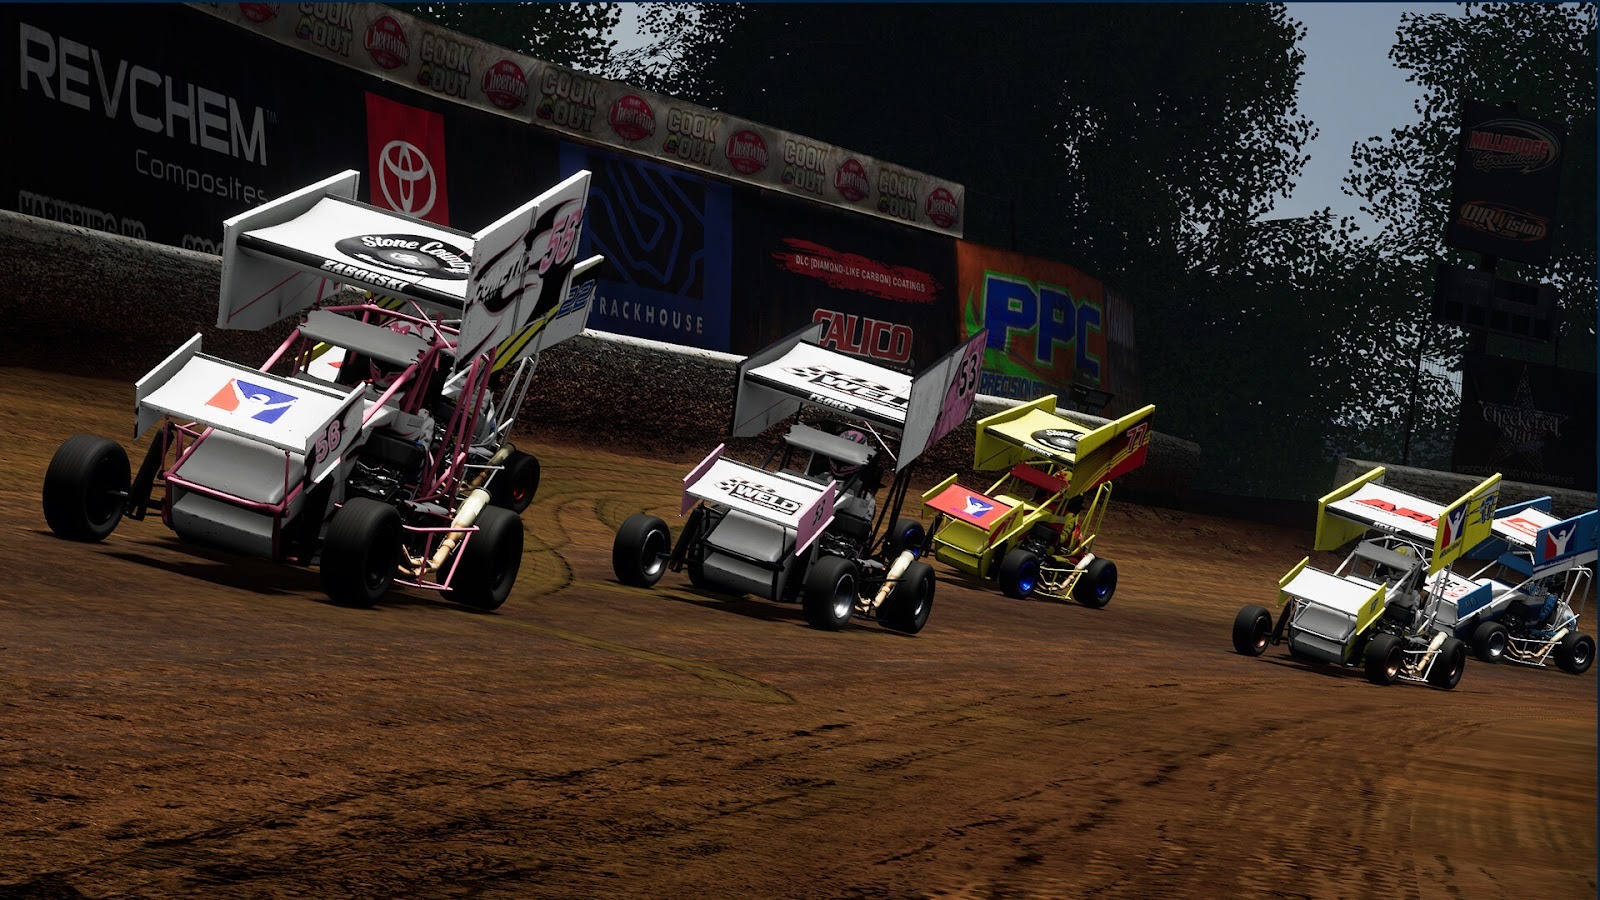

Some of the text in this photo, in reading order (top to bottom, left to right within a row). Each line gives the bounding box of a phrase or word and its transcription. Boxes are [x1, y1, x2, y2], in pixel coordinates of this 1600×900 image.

[312, 20, 353, 57] OUT
[420, 30, 474, 76] COOK
[19, 22, 267, 167] REVCHEM
[431, 66, 470, 99] OUT
[541, 65, 599, 110] COOK
[552, 100, 596, 132] OUT
[667, 107, 720, 144] COOK
[677, 134, 716, 166] OUT
[784, 140, 828, 175] COOK
[1468, 130, 1549, 159] MILLBRIDGE
[135, 149, 269, 204] Composites
[794, 166, 825, 195] OUT
[878, 167, 917, 202] COOK
[889, 194, 916, 221] OUT
[361, 235, 420, 250] Stone
[540, 208, 581, 273] 56
[320, 259, 410, 291] ZABORSKI
[795, 254, 810, 267] DLC
[892, 277, 926, 293] COATINGS
[981, 270, 1102, 384] PPC
[958, 353, 978, 398] 53
[315, 419, 341, 463] 56
[1126, 421, 1148, 452] 77
[734, 484, 801, 512] WELD
